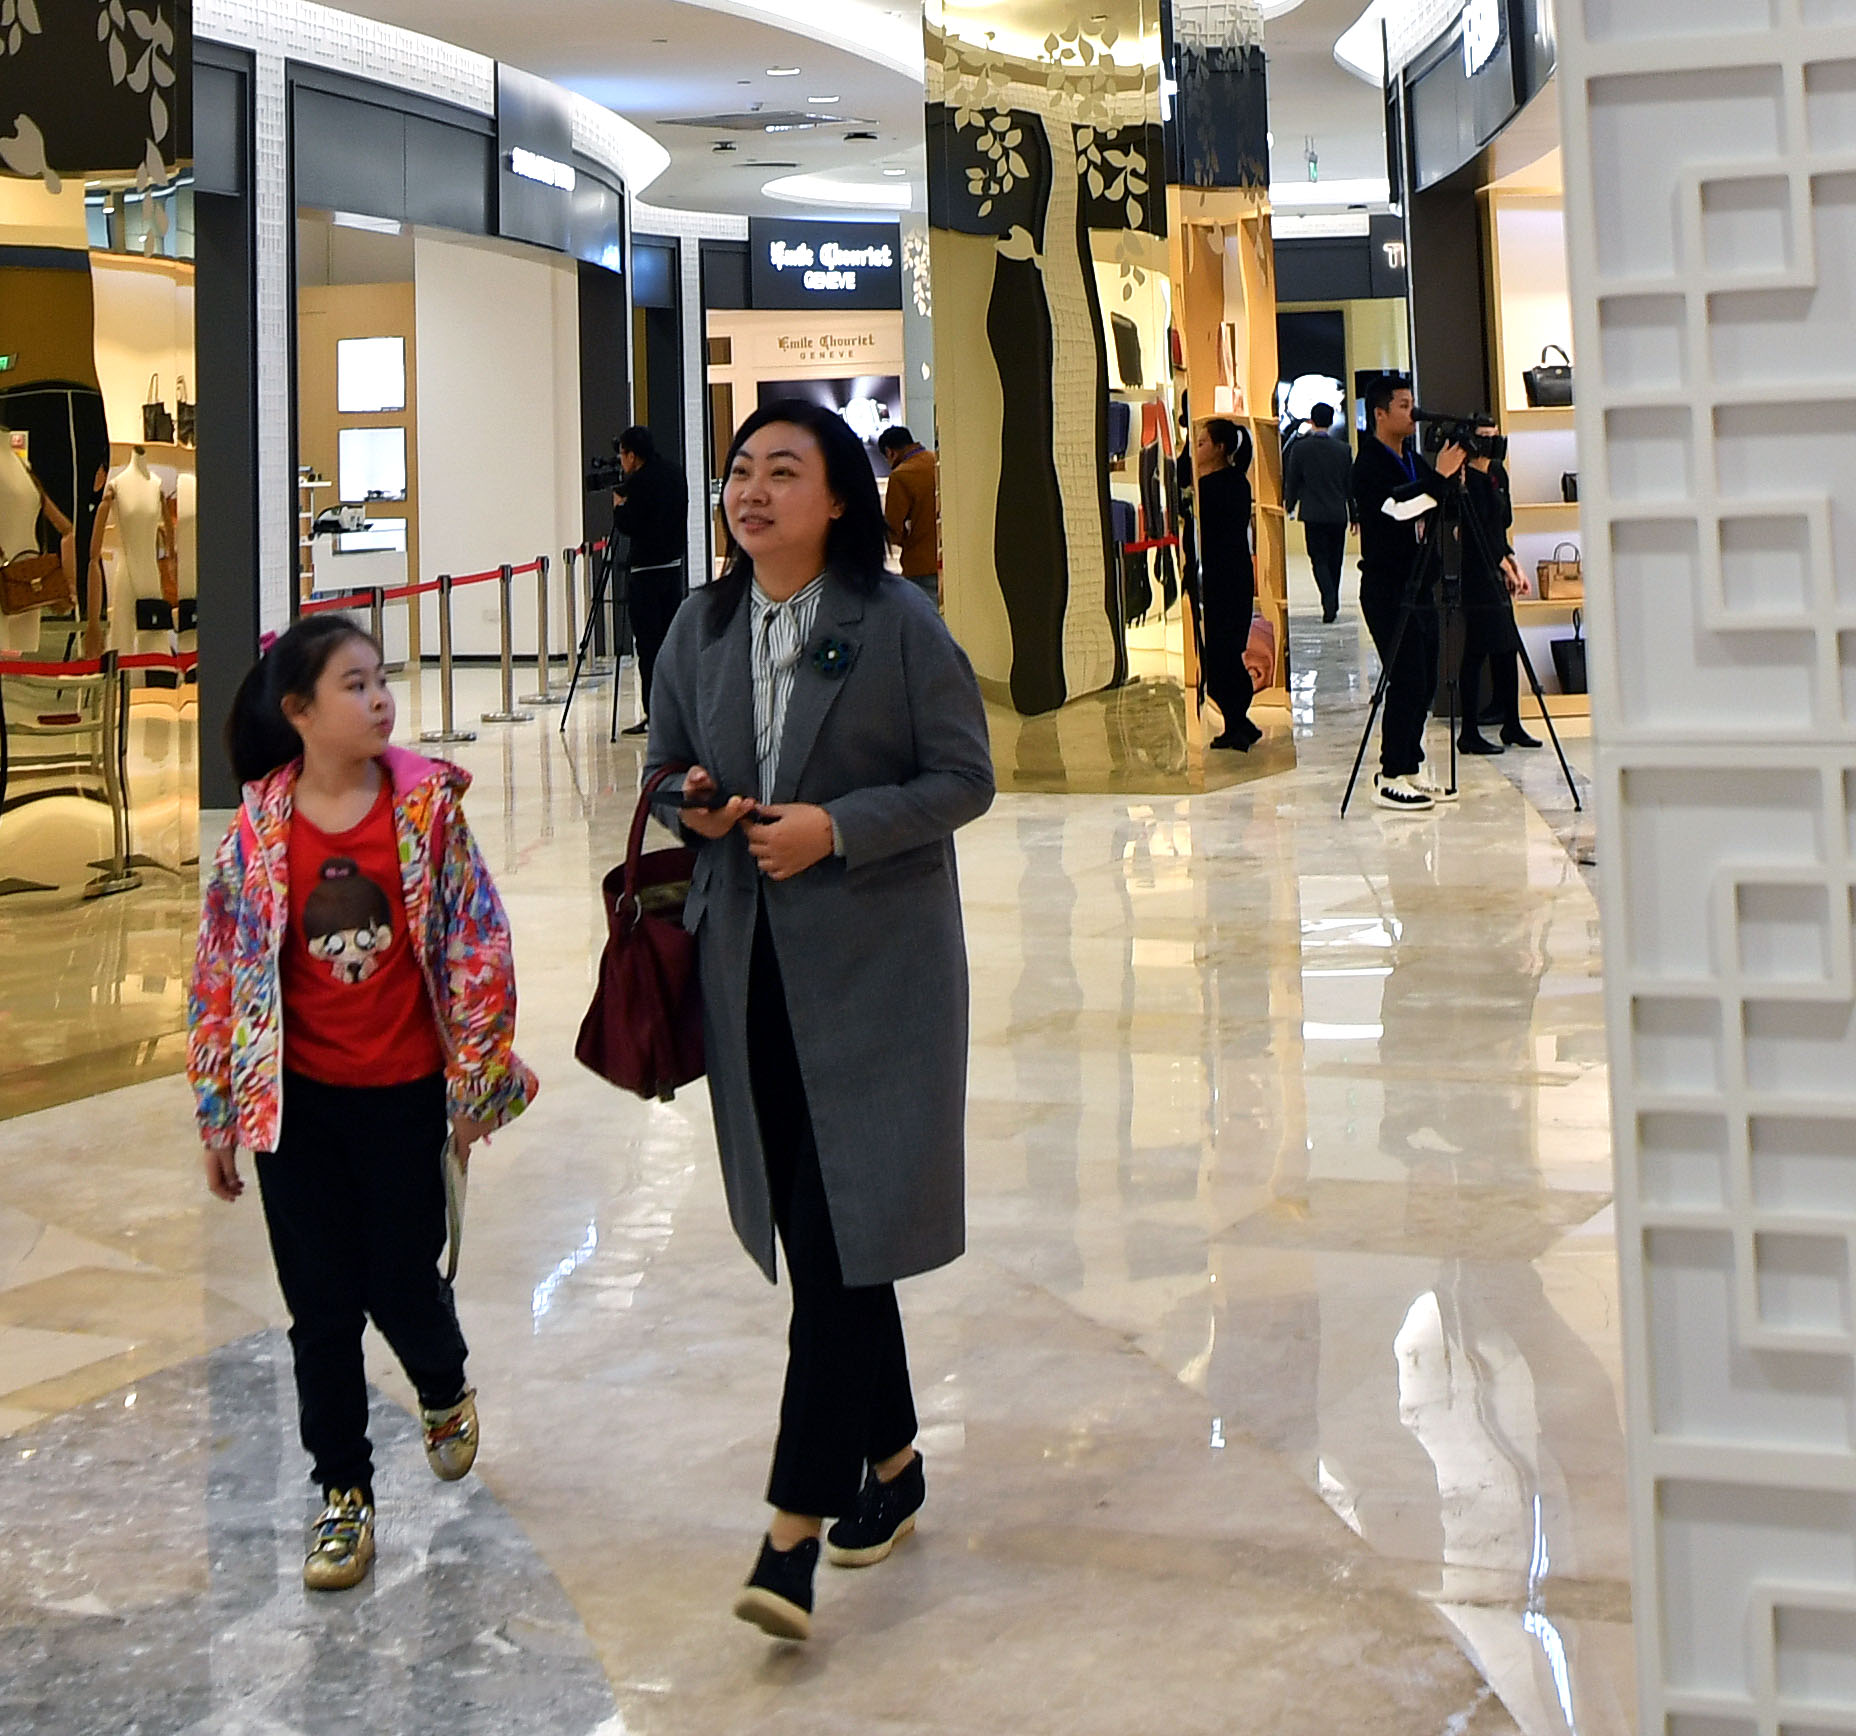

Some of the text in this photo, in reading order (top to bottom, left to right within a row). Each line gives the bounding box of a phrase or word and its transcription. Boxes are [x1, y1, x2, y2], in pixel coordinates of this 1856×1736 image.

[777, 333, 876, 352] Emile Chouriet
[799, 350, 855, 361] GENEVE
